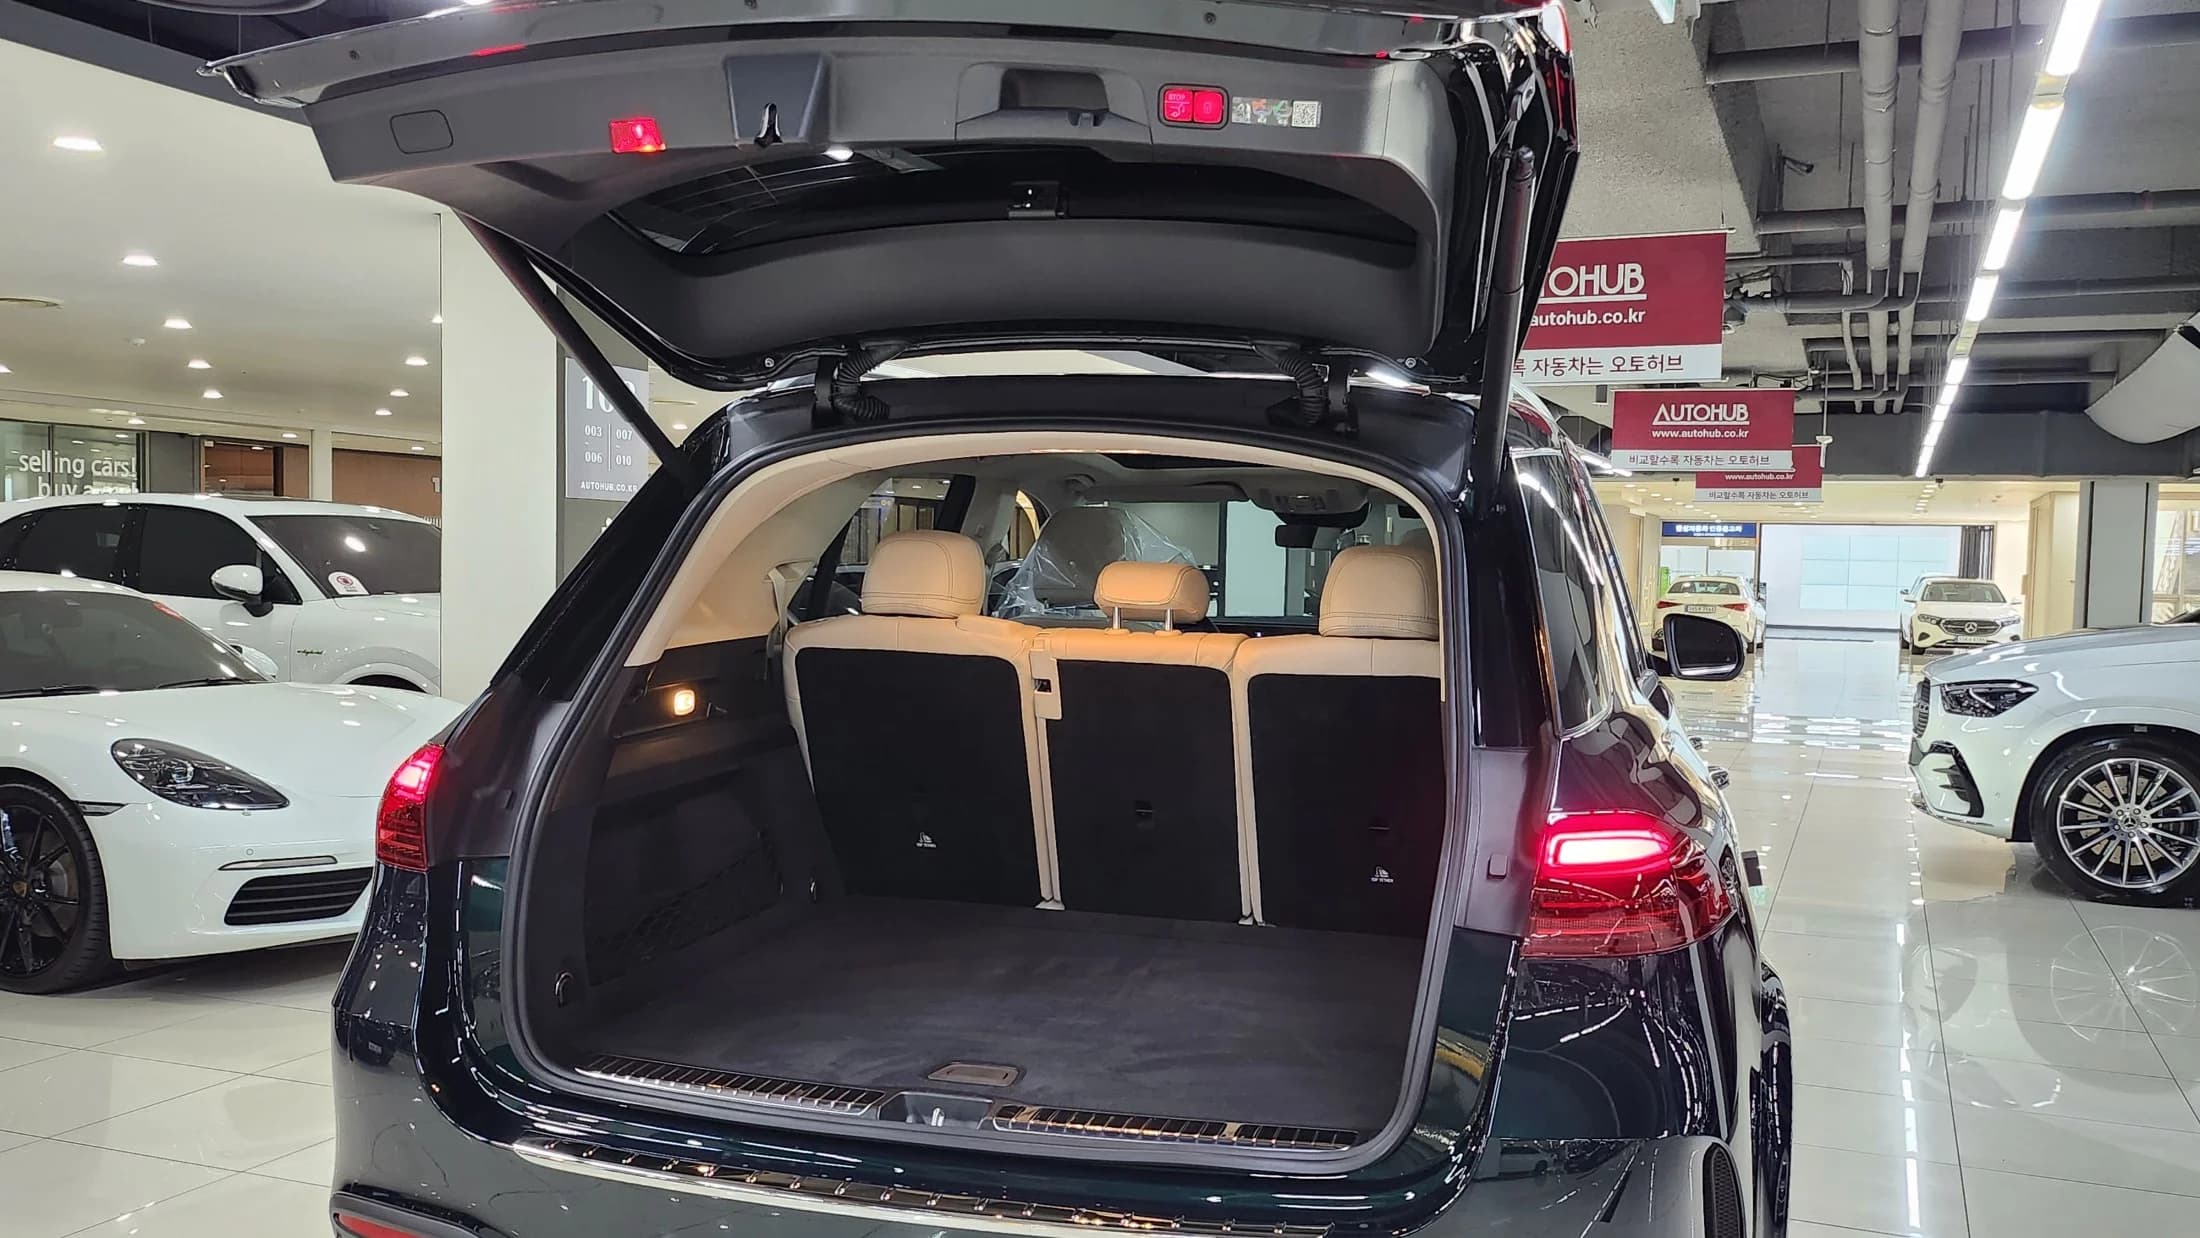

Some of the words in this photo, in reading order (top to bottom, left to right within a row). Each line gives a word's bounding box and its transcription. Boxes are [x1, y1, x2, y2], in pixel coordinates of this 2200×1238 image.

[1532, 356, 1604, 377] 자동차는
[1609, 354, 1684, 374] 오토허브
[1652, 403, 1750, 425] AUTOHUB
[584, 425, 603, 438] 003
[615, 428, 633, 441] 007
[1651, 428, 1750, 438] www.autohub.co.kr
[584, 451, 603, 464] 006
[615, 454, 632, 467] 010
[1629, 455, 1680, 466] 비교할수록
[1683, 454, 1726, 466] 자동차는
[1727, 454, 1771, 466] 오토허브
[18, 450, 86, 479] selling
[91, 456, 138, 478] cars!
[1725, 472, 1795, 482] www.autohub.co.kr
[1779, 490, 1809, 499] 오토허브
